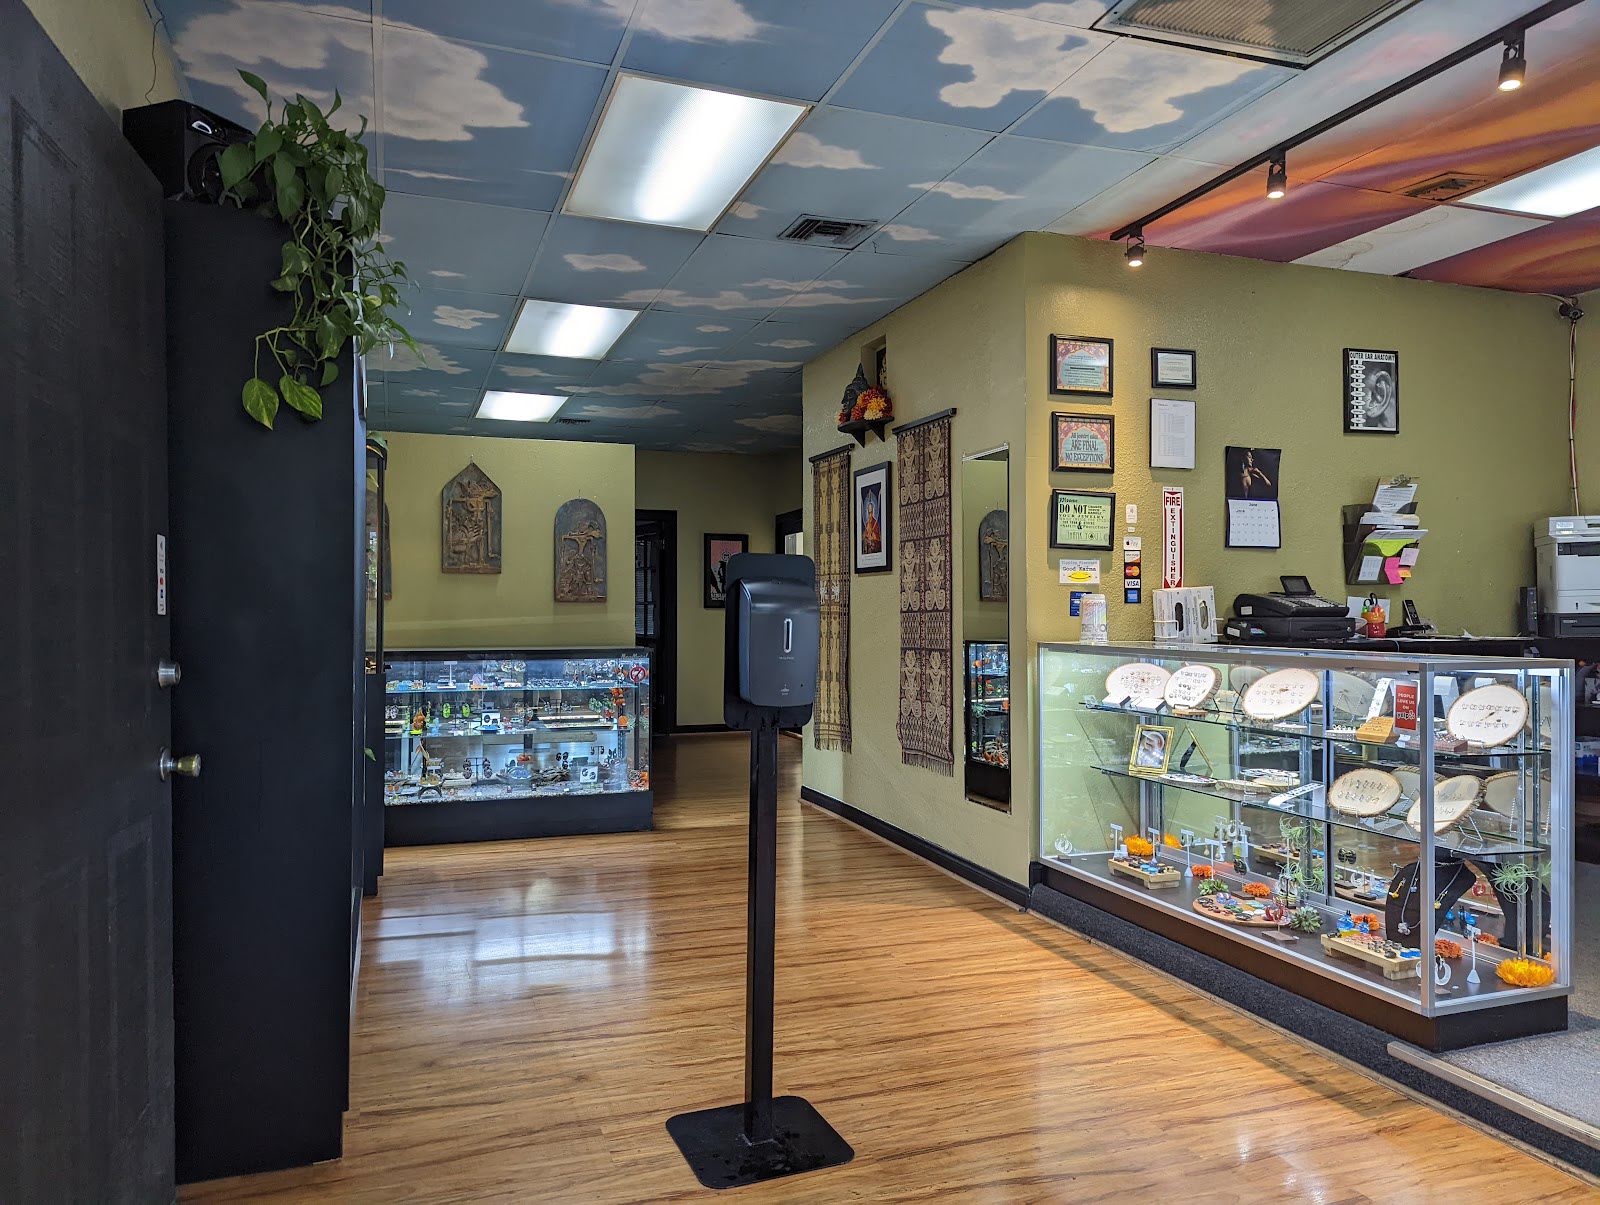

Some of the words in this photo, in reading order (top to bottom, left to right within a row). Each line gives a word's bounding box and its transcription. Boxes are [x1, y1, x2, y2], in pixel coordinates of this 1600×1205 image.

[1350, 352, 1363, 360] OUTER
[1071, 440, 1082, 450] ARE
[1082, 440, 1098, 450] FINAL
[1066, 452, 1073, 461] NO
[1074, 453, 1104, 462] EXCEPTIONS
[1166, 496, 1180, 506] FIRE
[1060, 504, 1070, 514] DO
[1074, 504, 1088, 514] NOT
